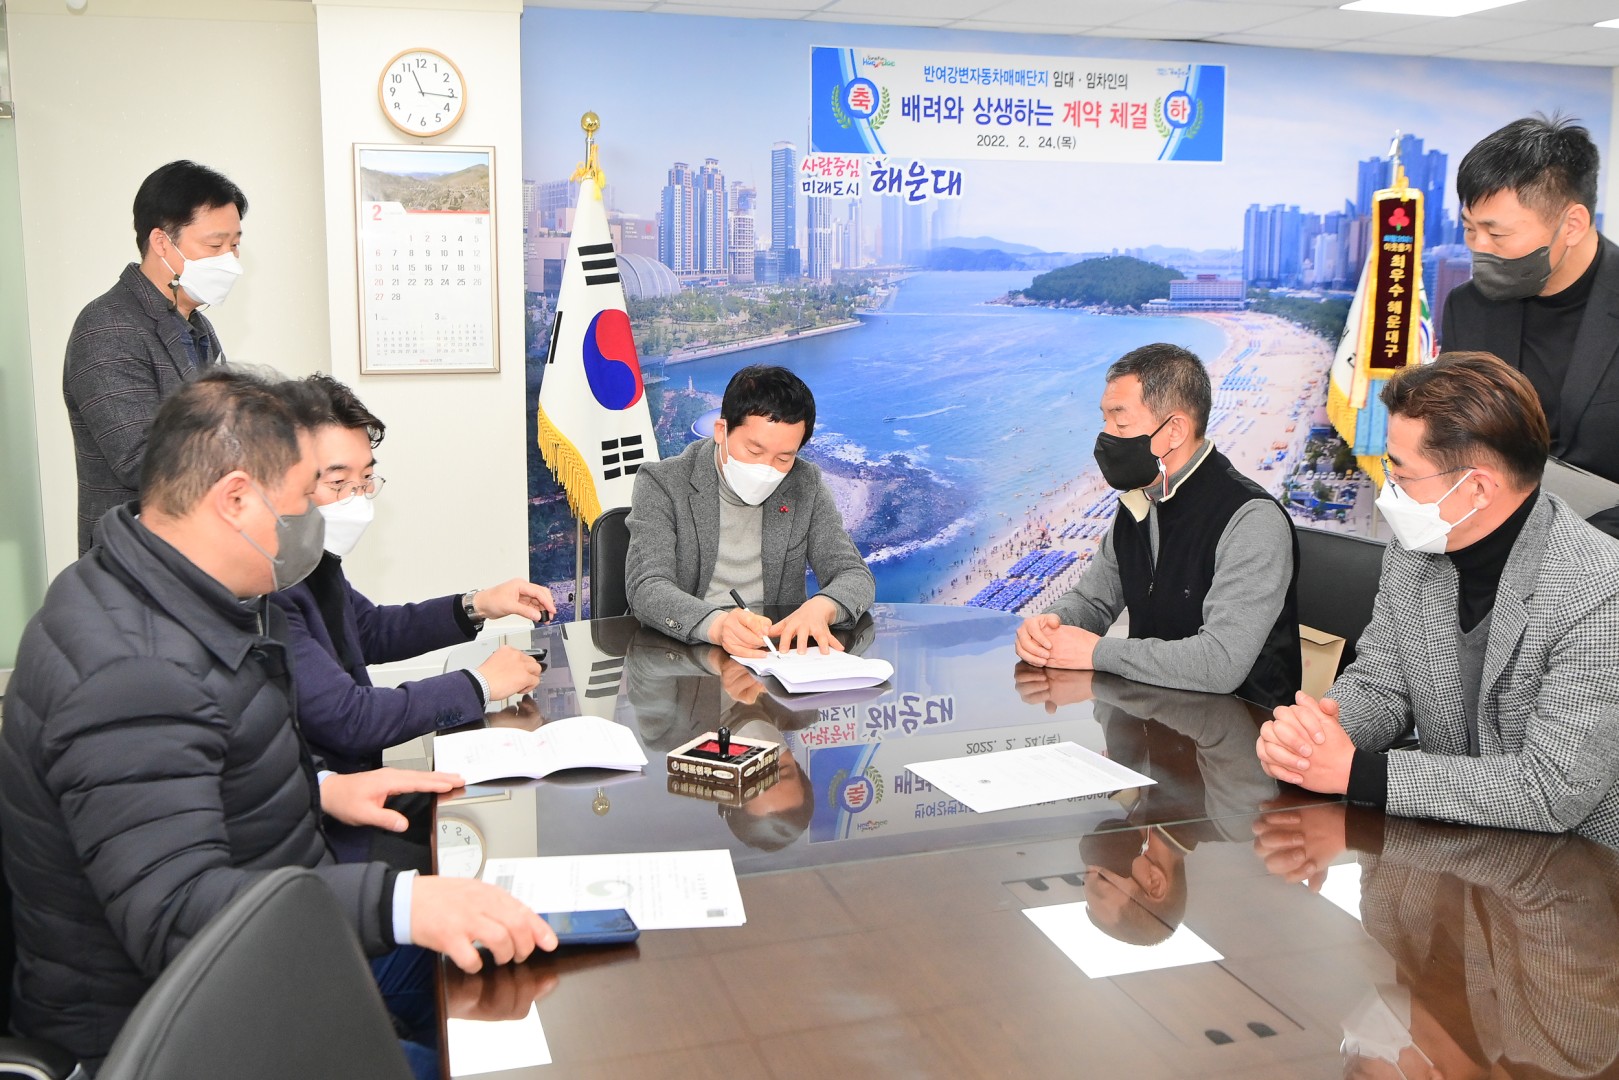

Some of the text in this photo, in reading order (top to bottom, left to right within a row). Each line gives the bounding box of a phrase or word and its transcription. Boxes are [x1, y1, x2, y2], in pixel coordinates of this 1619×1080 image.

[402, 63, 411, 72] 11
[416, 58, 427, 68] 12
[434, 64, 438, 72] 1
[391, 74, 402, 83] 10
[443, 72, 450, 82] 2
[923, 65, 1049, 88] 반여강변자동차매매단지
[1053, 71, 1075, 88] 임대
[1085, 72, 1129, 90] 임차인의
[389, 86, 396, 96] 9
[850, 87, 872, 111] 축
[443, 102, 450, 112] 4
[901, 94, 1149, 130] 배려와 상생하는 계약 체결
[1170, 99, 1188, 120] 하
[420, 116, 426, 126] 6
[435, 113, 441, 122] 5
[976, 134, 1077, 151] 2022. 2. 24.(목)
[801, 157, 861, 178] 사람중심
[869, 160, 963, 202] 해운대
[801, 180, 860, 197] 미래도시
[372, 204, 382, 221] 2
[441, 235, 447, 243] 3
[457, 235, 463, 243] 4
[393, 249, 397, 257] 7
[409, 249, 414, 257] 8
[425, 249, 431, 257] 9
[441, 249, 448, 257] 10
[458, 249, 464, 257] 11
[392, 264, 399, 272] 14
[408, 264, 416, 272] 15
[425, 264, 432, 272] 16
[441, 264, 449, 272] 17
[457, 264, 465, 272] 18
[374, 278, 384, 286] 20
[392, 278, 400, 286] 21
[407, 278, 417, 286] 22
[424, 278, 433, 286] 23
[440, 278, 450, 286] 24
[457, 278, 466, 286] 25
[375, 293, 401, 301] 27 28
[1384, 300, 1404, 358] 해운대구
